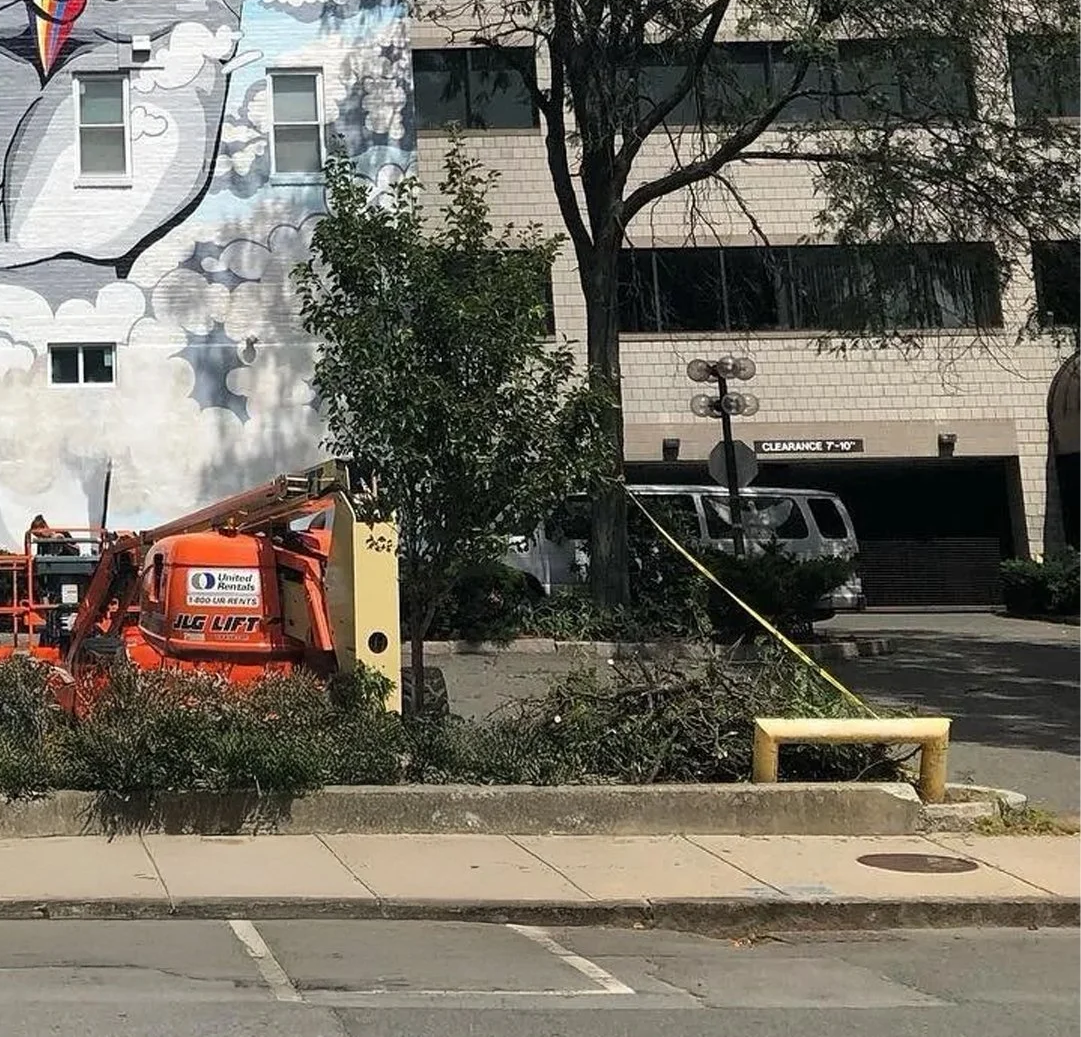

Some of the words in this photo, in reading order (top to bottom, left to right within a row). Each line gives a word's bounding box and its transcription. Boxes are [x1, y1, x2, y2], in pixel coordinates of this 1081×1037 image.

[761, 441, 823, 452] CLEARANCE
[217, 573, 254, 583] United
[216, 582, 256, 592] Rentals
[173, 614, 208, 630] JLG
[210, 615, 261, 632] LIFT
